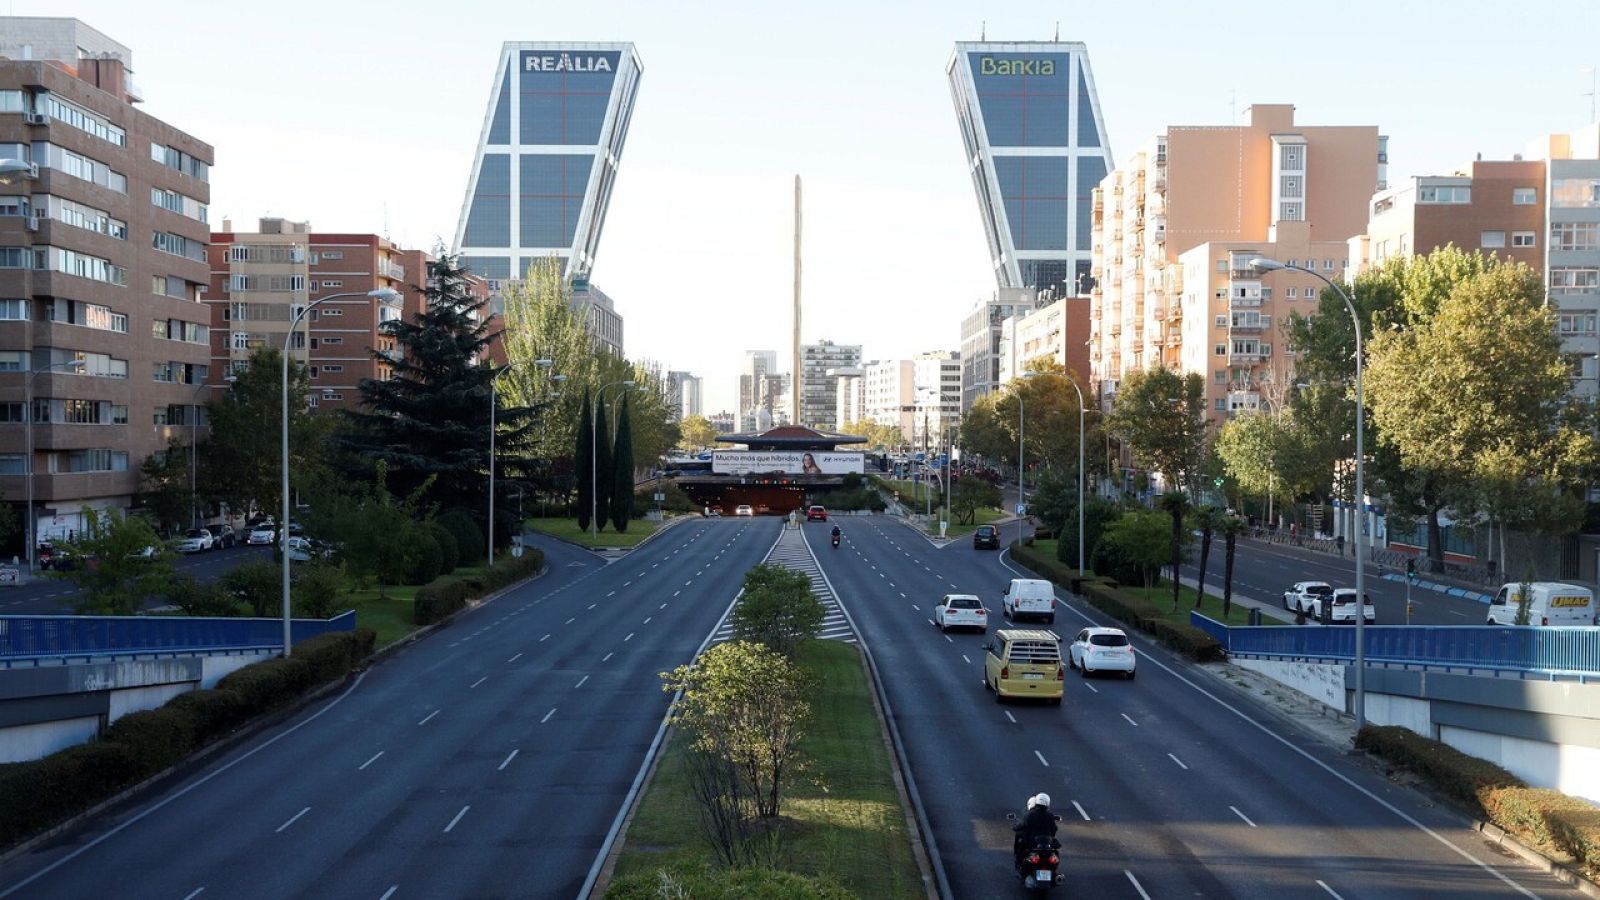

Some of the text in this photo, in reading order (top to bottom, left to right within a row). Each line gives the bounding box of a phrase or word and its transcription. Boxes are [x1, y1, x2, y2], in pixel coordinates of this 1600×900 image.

[525, 56, 611, 71] REALIA
[981, 57, 1055, 75] Bankia
[756, 455, 770, 463] que
